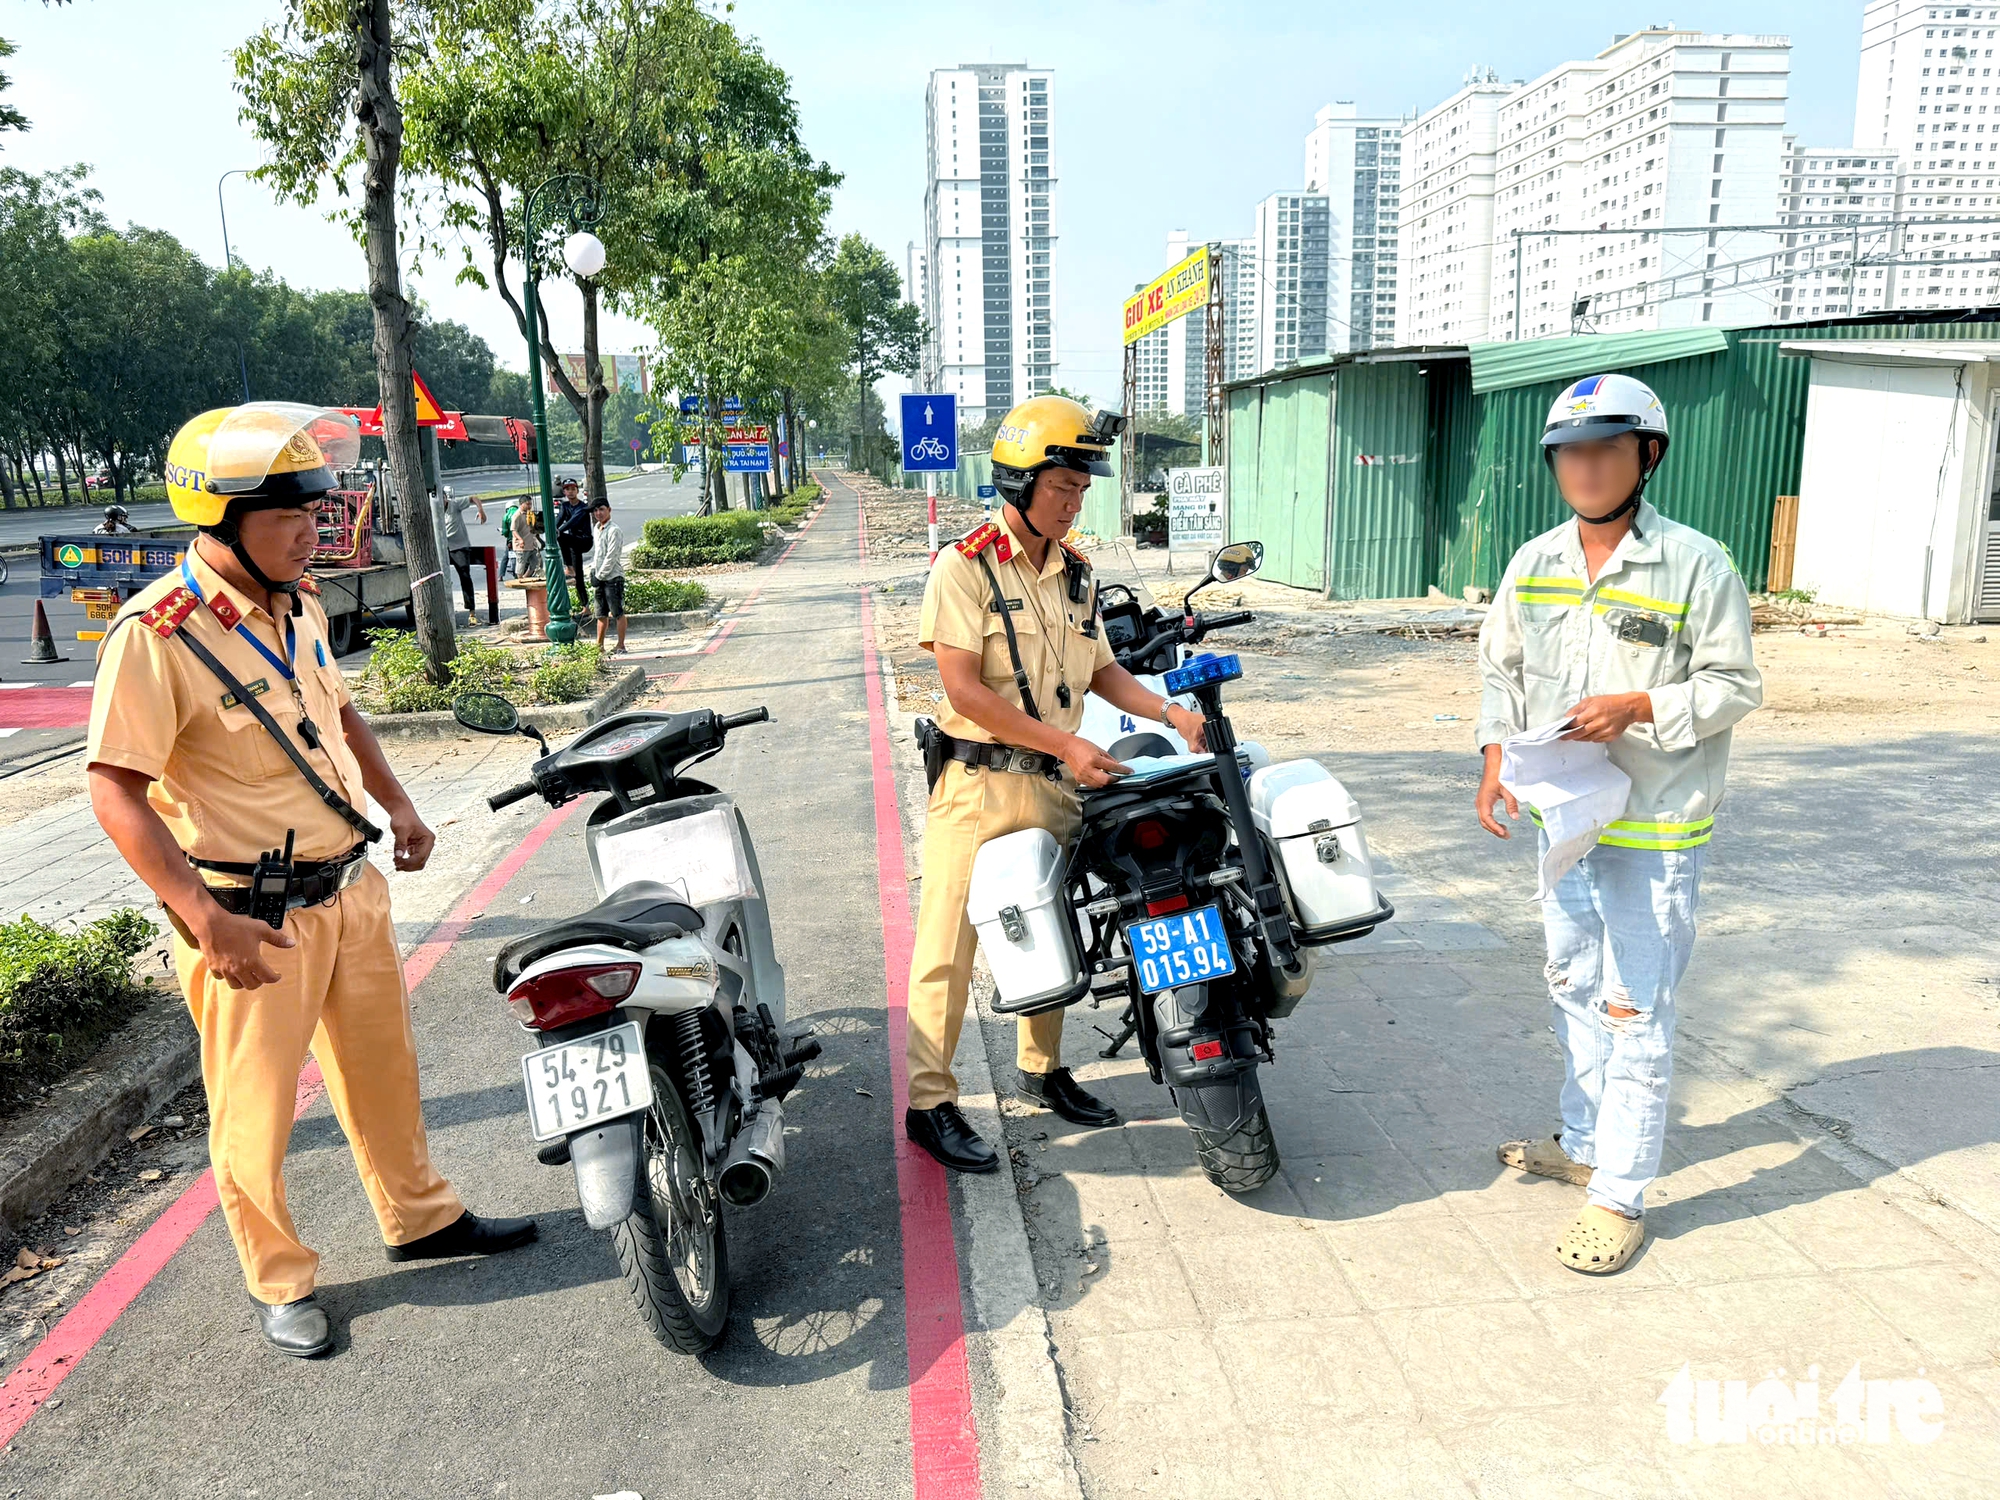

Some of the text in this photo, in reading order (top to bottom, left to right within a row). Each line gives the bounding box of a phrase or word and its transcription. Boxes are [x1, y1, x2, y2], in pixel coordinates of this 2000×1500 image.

[1147, 285, 1164, 316] XE
[1166, 278, 1175, 300] AN
[1176, 260, 1204, 293] KHÁNH
[1174, 471, 1221, 494] CÀ PHÊ
[1204, 512, 1222, 531] SÁNG
[102, 550, 132, 564] 50H
[96, 604, 112, 612] 50H
[1120, 714, 1136, 733] 4
[1140, 912, 1210, 954] 59-A1
[1142, 942, 1227, 987] 015.94
[542, 1033, 627, 1088] 54-Z9
[548, 1071, 631, 1128] 1921
